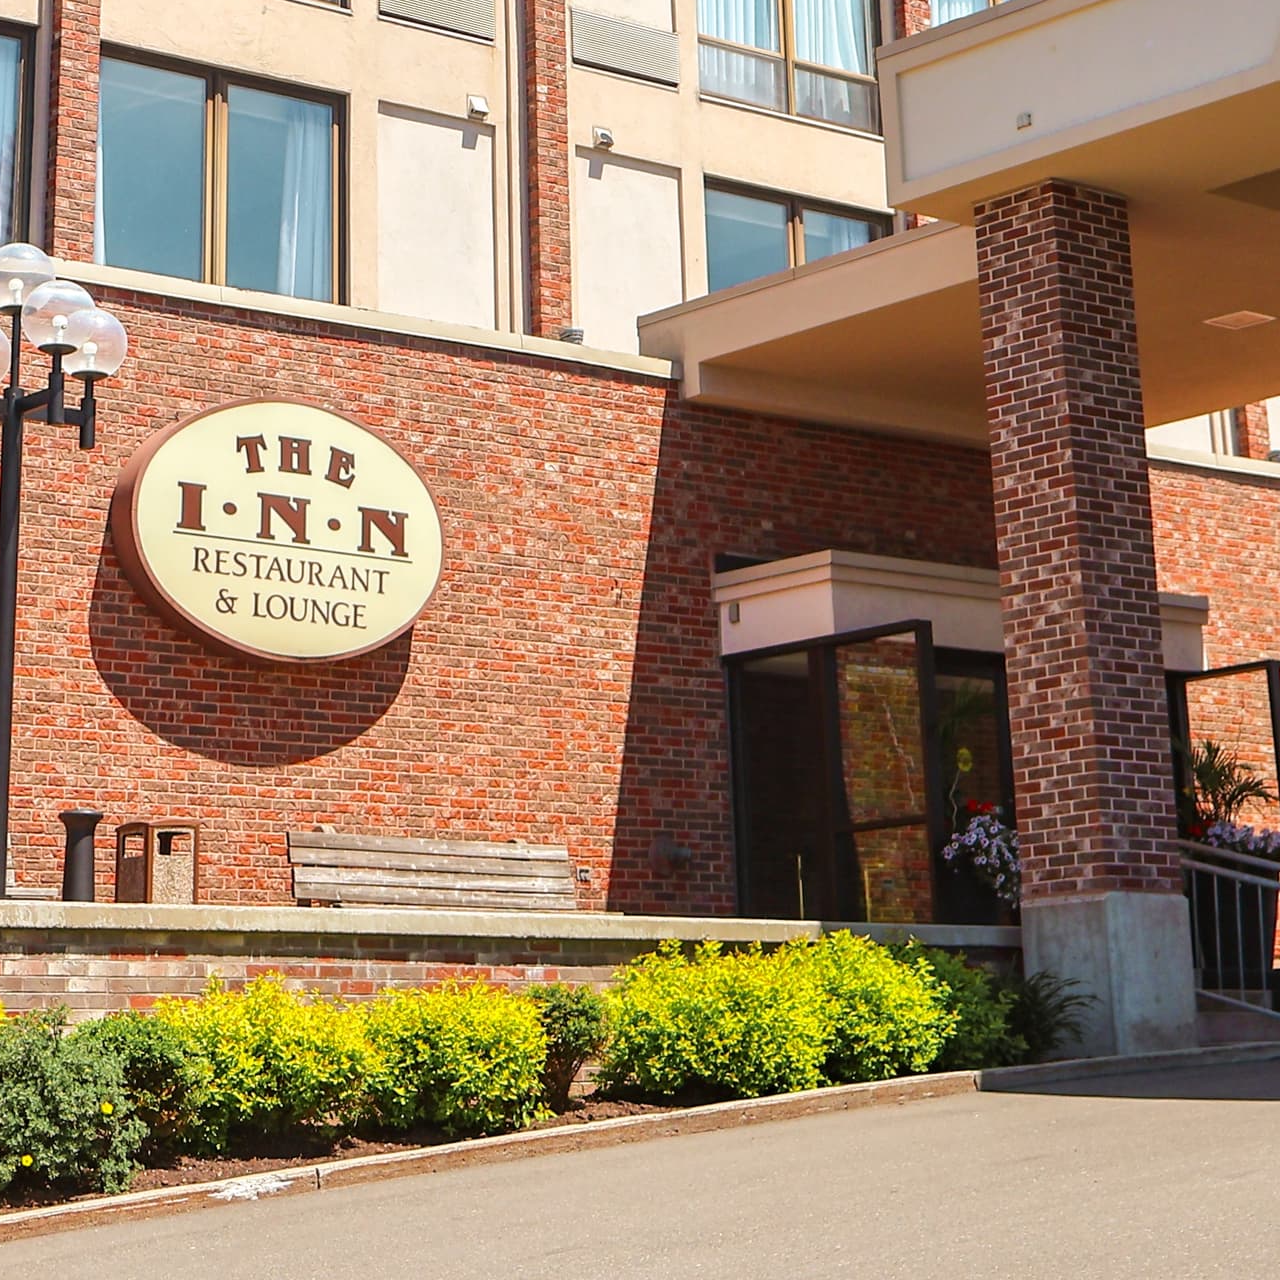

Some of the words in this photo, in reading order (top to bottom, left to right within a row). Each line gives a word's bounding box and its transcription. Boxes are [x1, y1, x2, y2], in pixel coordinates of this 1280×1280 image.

[236, 434, 356, 489] THE
[192, 546, 390, 594] RESTAURANT
[215, 588, 238, 615] &
[252, 592, 368, 629] LOUNGE
